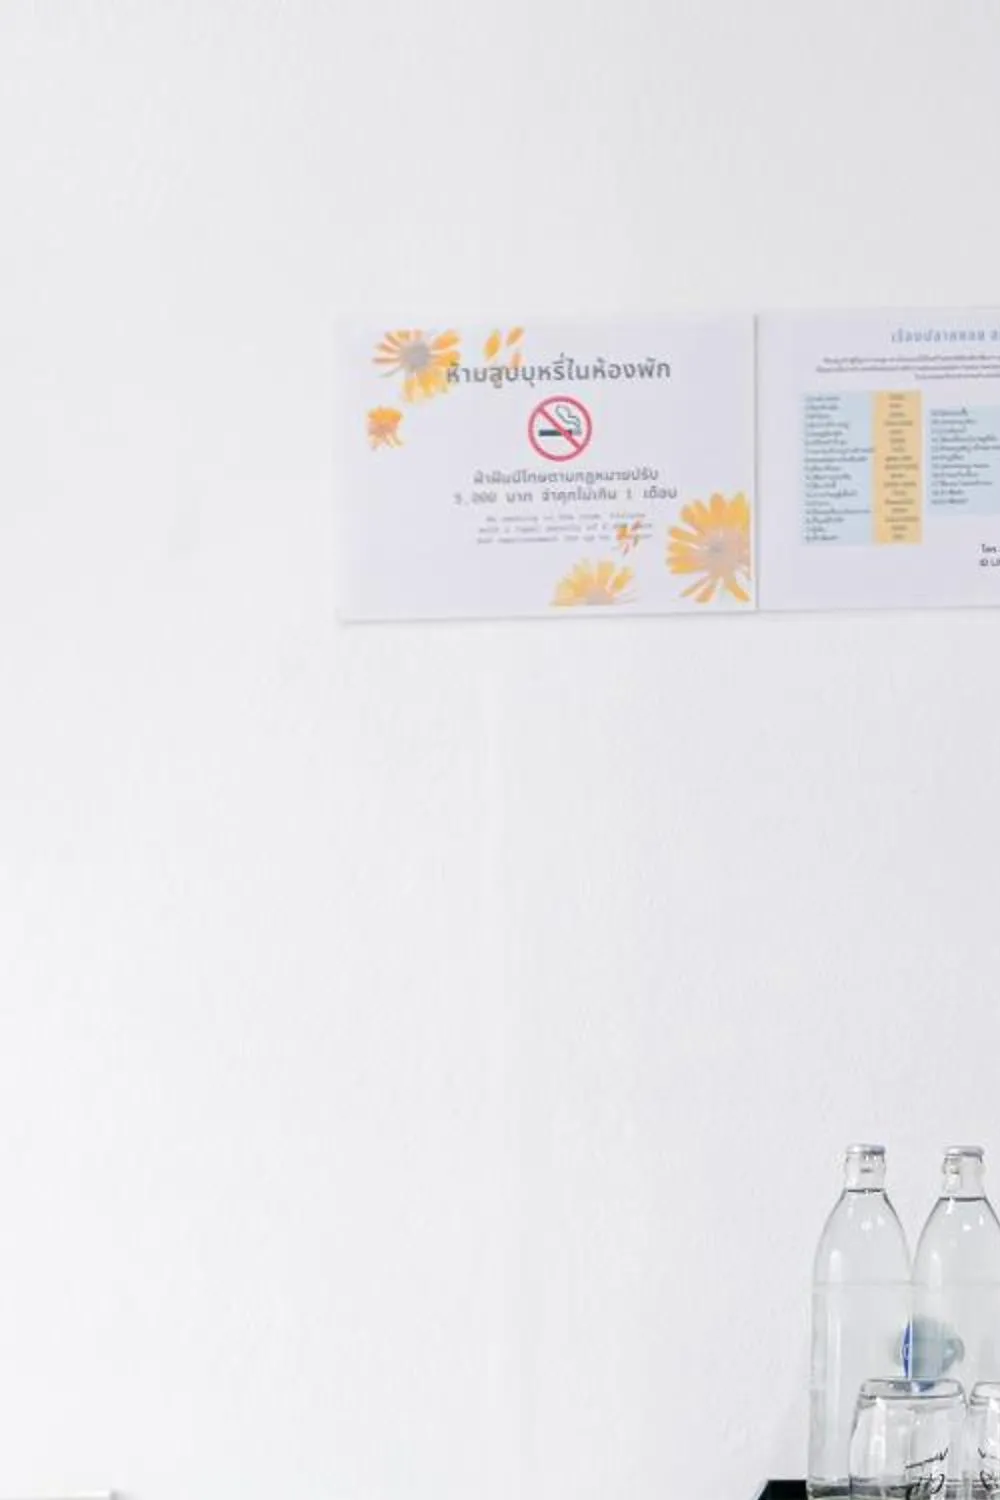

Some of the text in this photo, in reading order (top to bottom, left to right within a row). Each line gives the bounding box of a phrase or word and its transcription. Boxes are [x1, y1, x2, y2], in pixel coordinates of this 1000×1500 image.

[446, 352, 671, 389] ห้ามสูบบุหรี่ในห้องพัก
